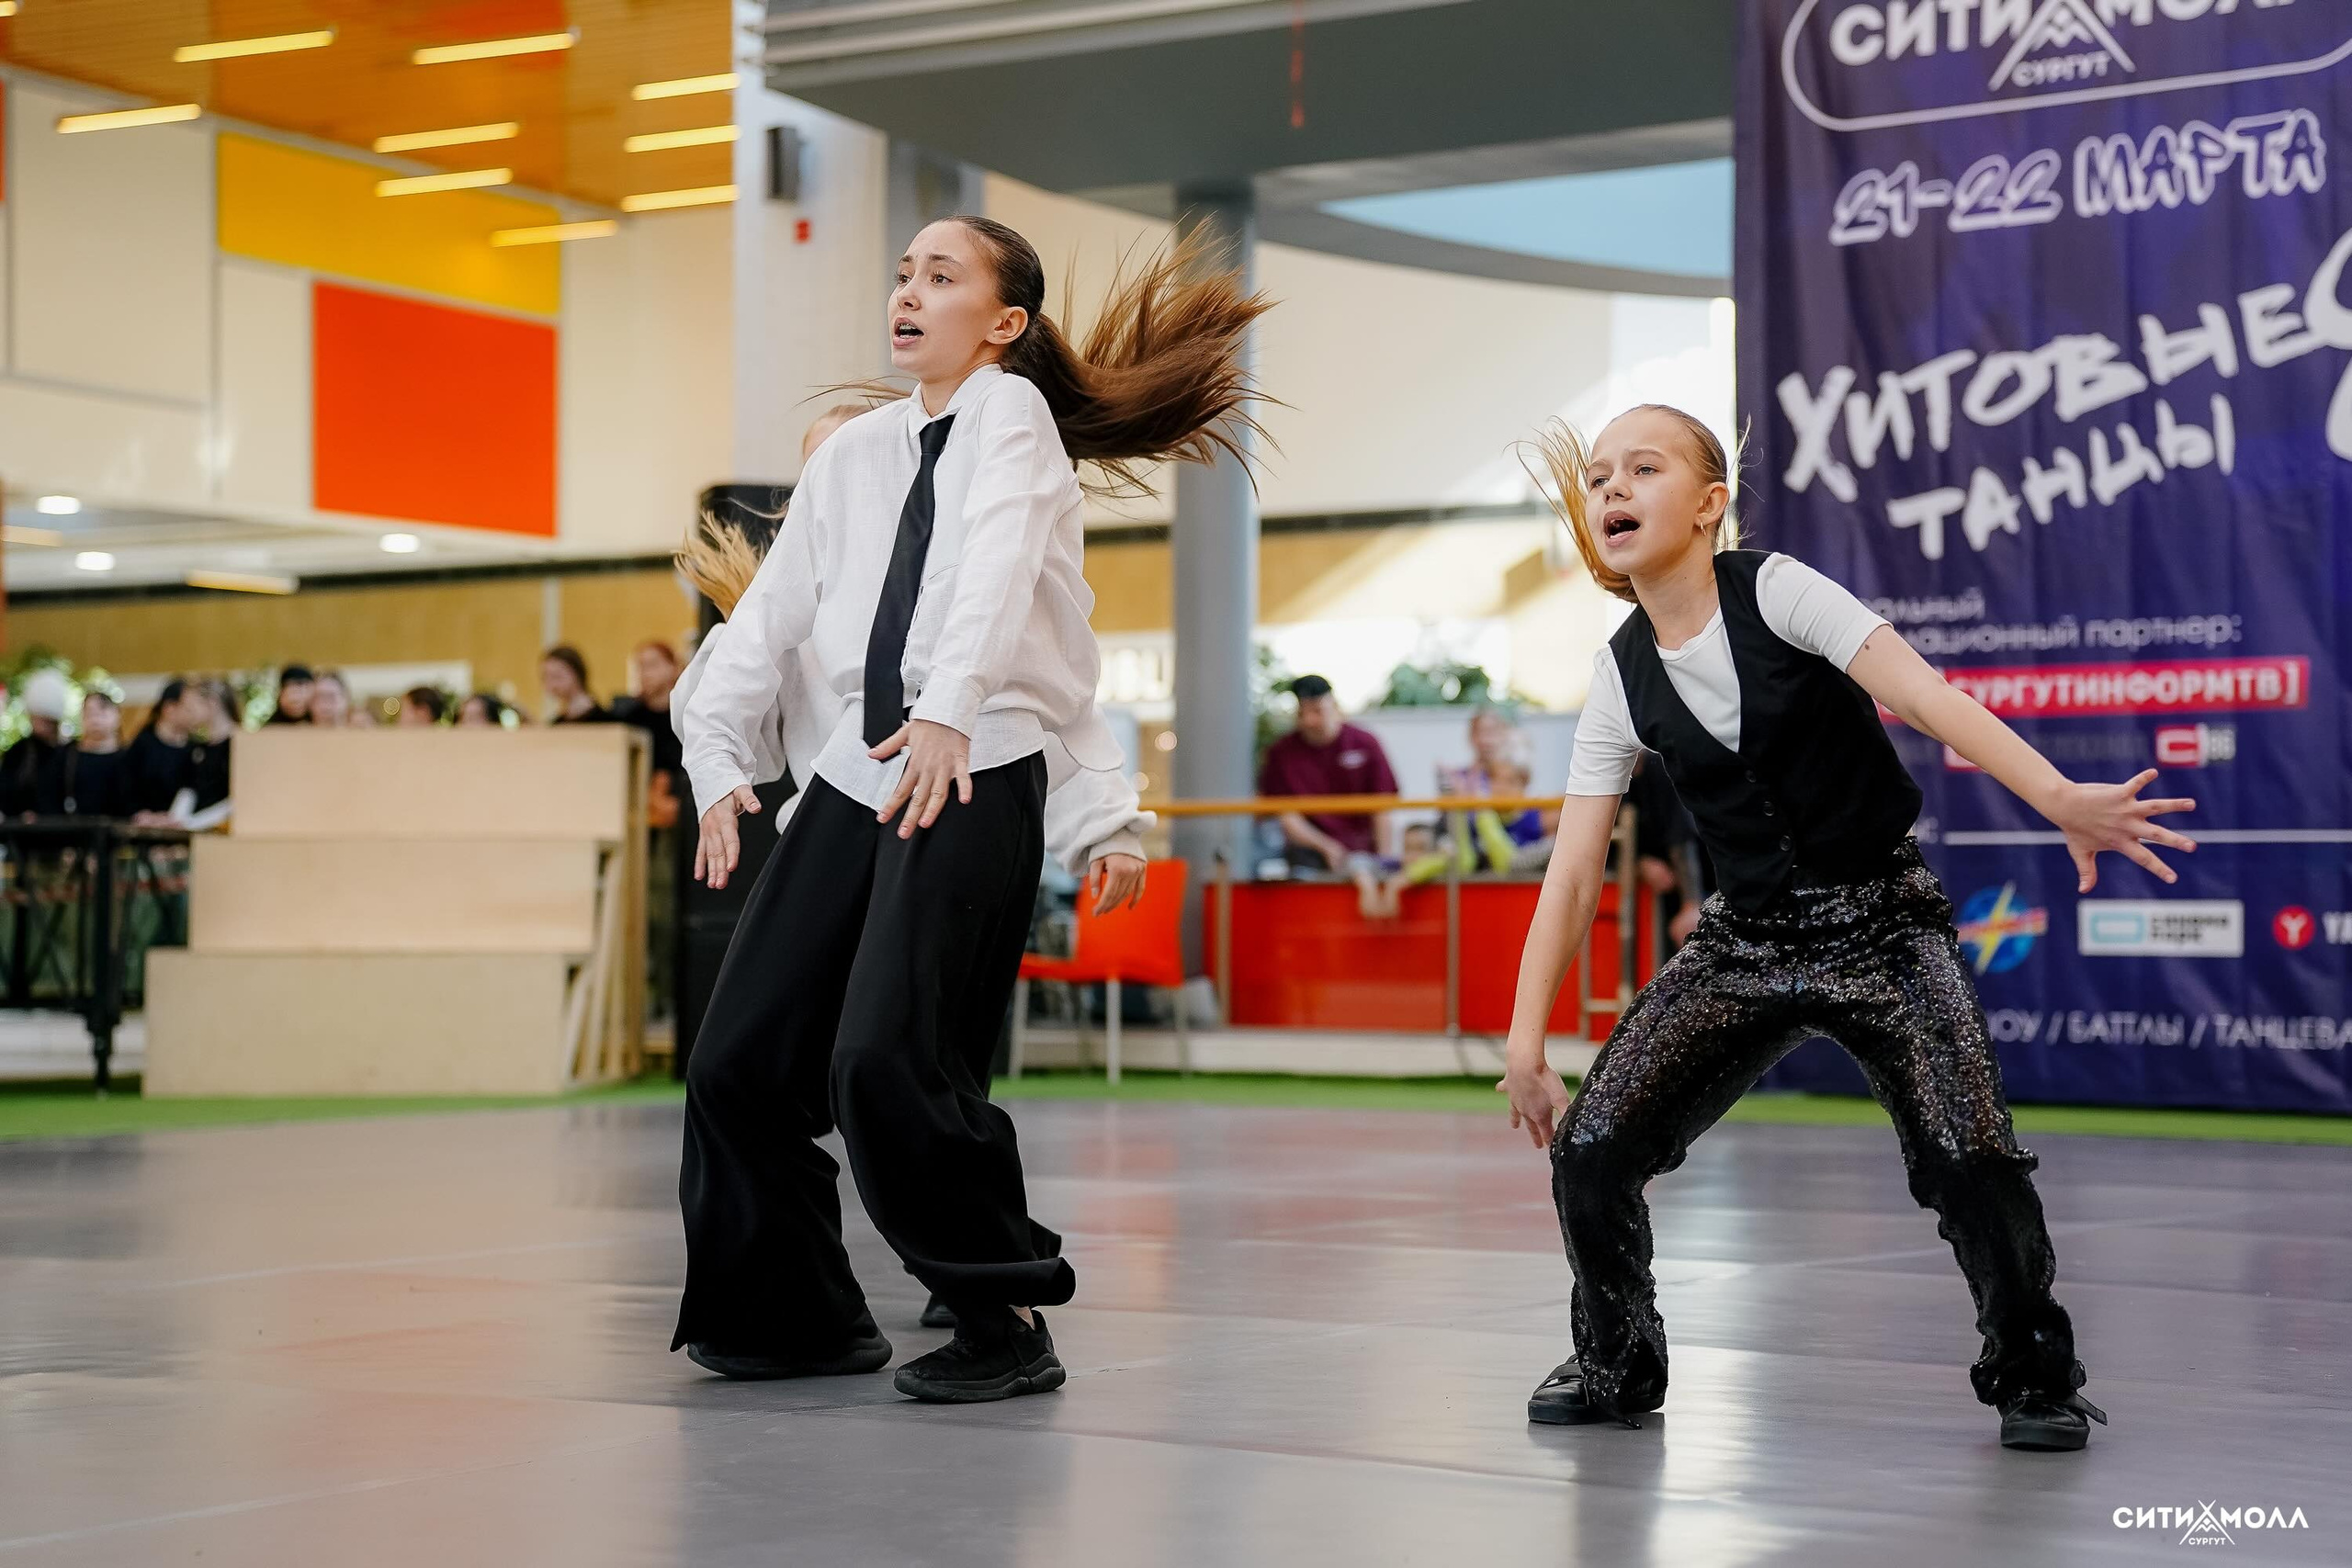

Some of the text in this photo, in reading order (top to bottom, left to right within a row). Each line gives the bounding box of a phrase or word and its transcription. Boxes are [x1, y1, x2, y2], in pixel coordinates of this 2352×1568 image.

[1829, 0, 2024, 66] СИТИ
[1830, 108, 2327, 247] 21-22 МАРТА
[1776, 283, 2308, 502] ХИТОВЫЕ
[1887, 393, 2235, 560] ТАНЦЫ
